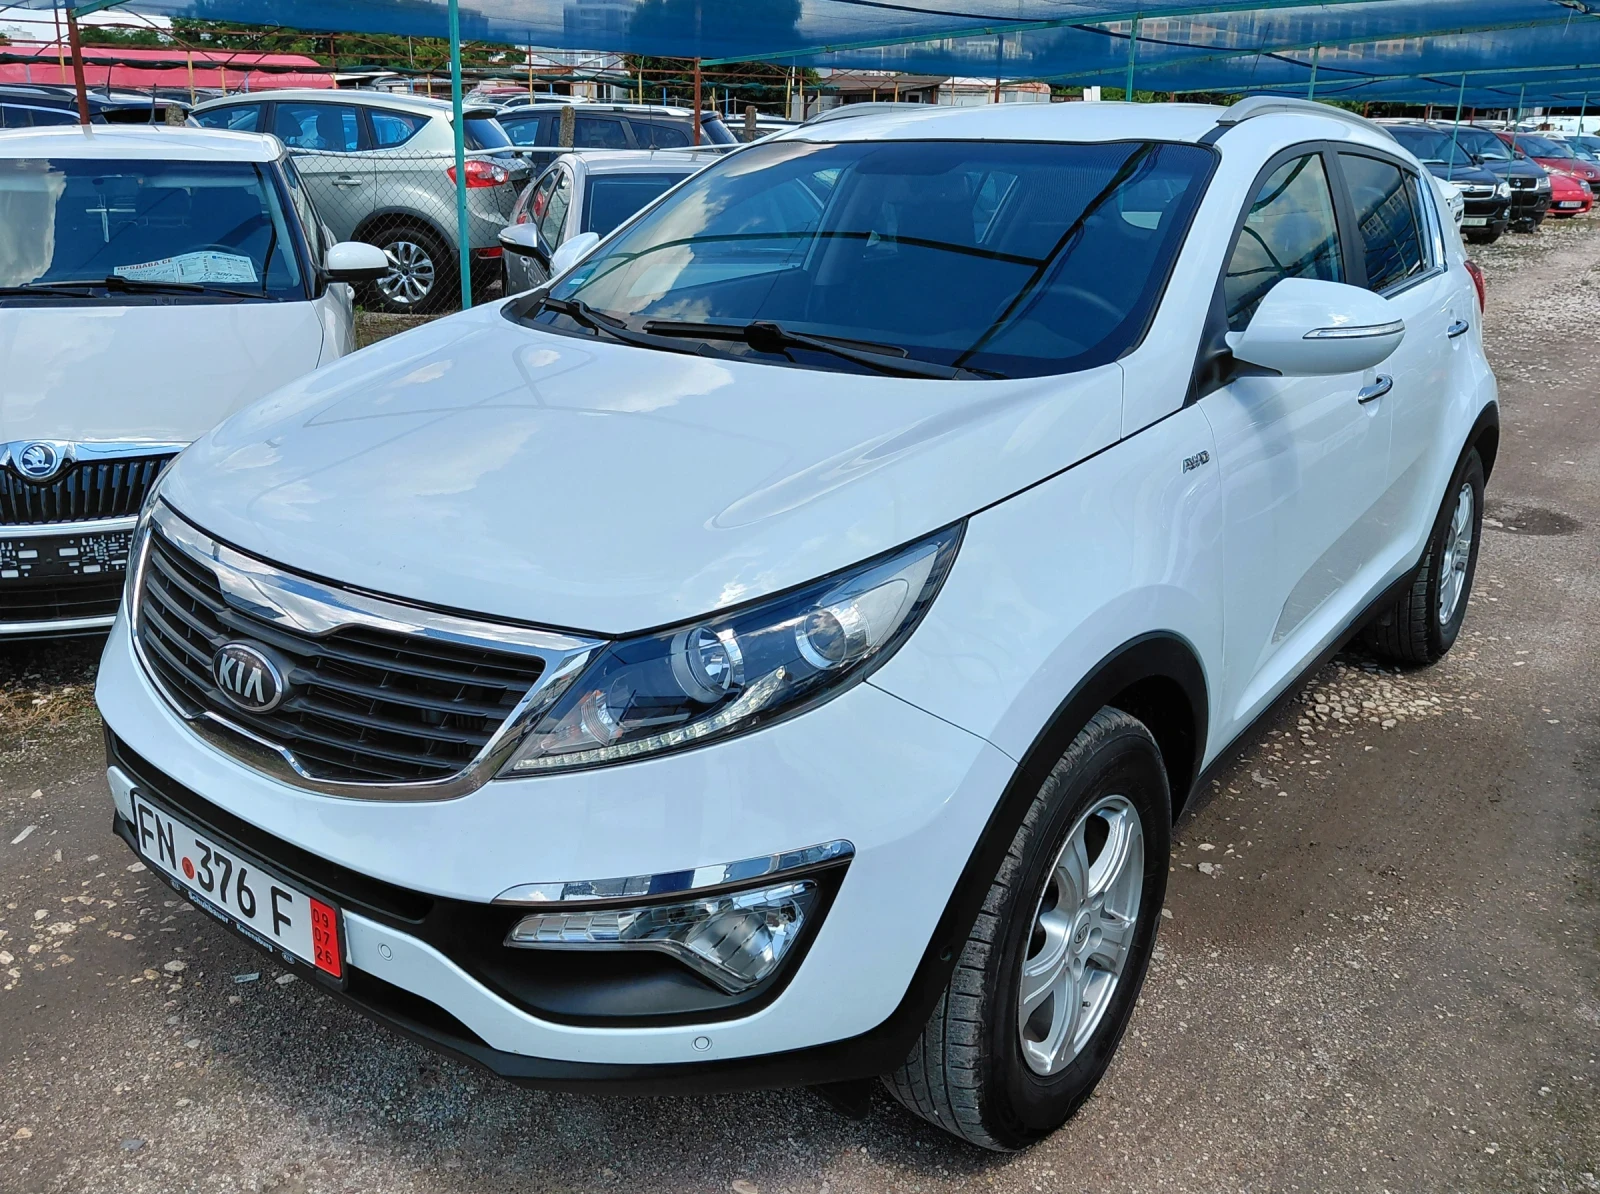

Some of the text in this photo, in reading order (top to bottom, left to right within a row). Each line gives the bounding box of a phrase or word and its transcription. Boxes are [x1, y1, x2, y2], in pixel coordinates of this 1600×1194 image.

[117, 261, 160, 271] ПРОДАВА
[1183, 450, 1210, 474] AWD
[219, 653, 265, 703] KIA
[137, 802, 293, 937] FN 376 F
[313, 907, 329, 929] 09
[235, 922, 274, 953] Ravensburg
[314, 926, 330, 946] 07
[316, 945, 333, 965] 26
